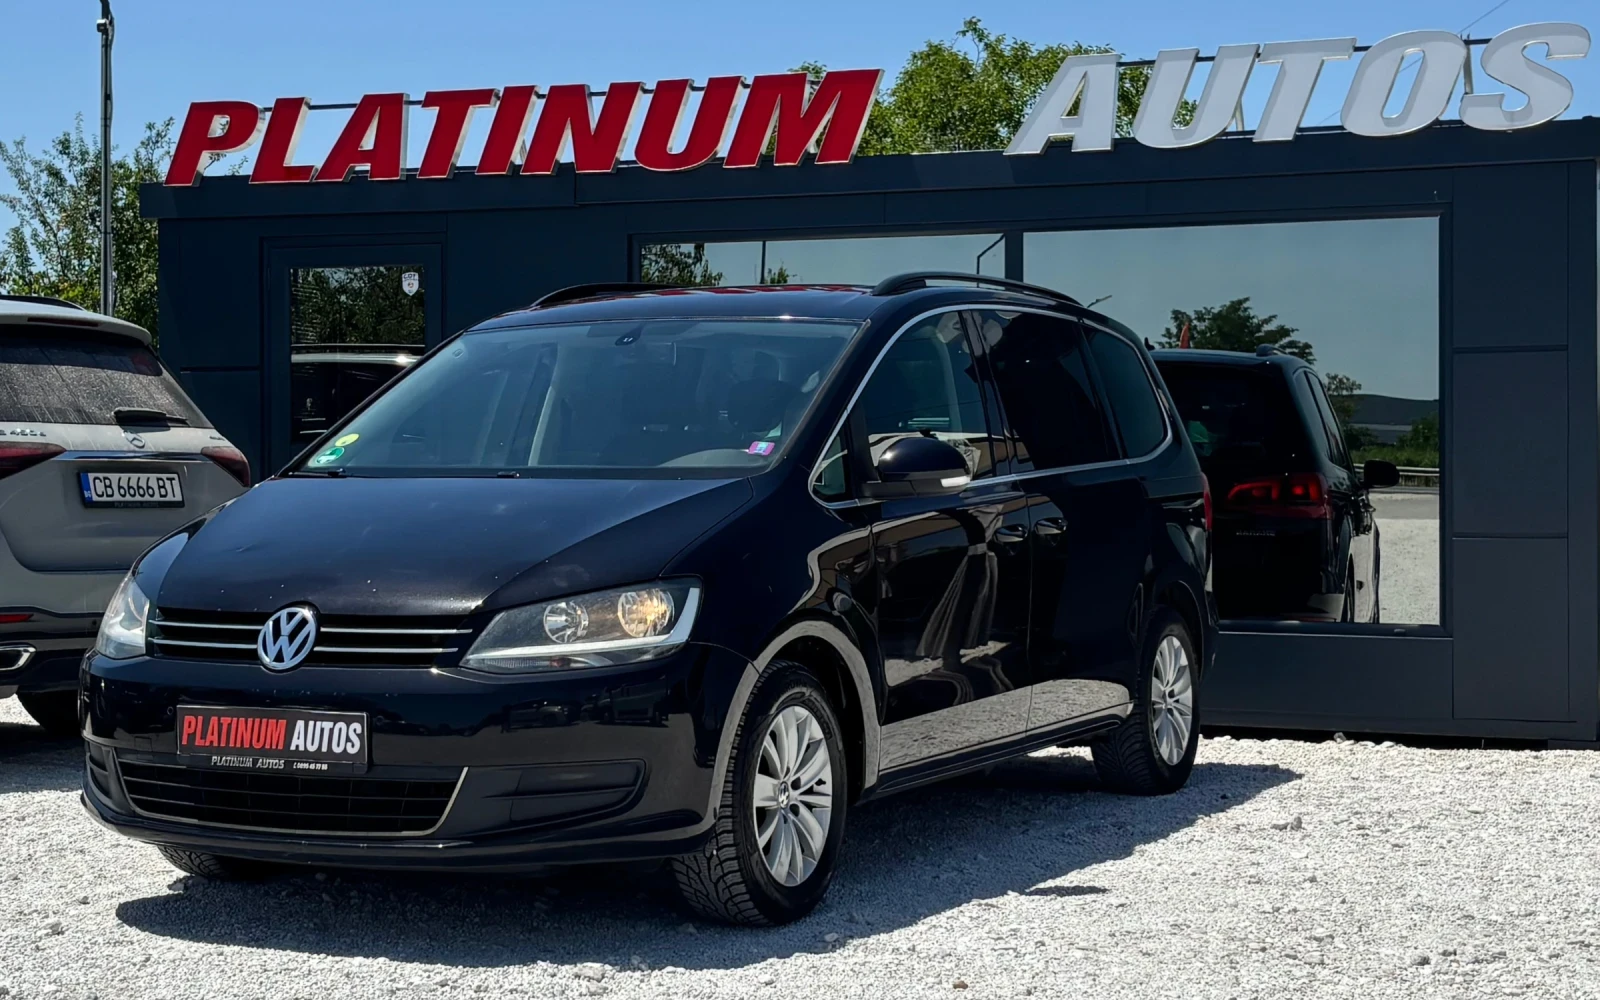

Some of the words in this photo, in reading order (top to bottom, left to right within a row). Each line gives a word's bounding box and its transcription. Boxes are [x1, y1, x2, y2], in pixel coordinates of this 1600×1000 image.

[163, 69, 884, 187] PLATINUM
[1003, 22, 1591, 156] AUTOS
[93, 476, 115, 498] CB
[117, 476, 156, 498] 6666
[156, 476, 176, 498] BT
[181, 715, 287, 750] PLATINUM
[290, 719, 363, 755] AUTOS
[211, 756, 252, 768] PLATINUM
[256, 758, 285, 769] AUTOS
